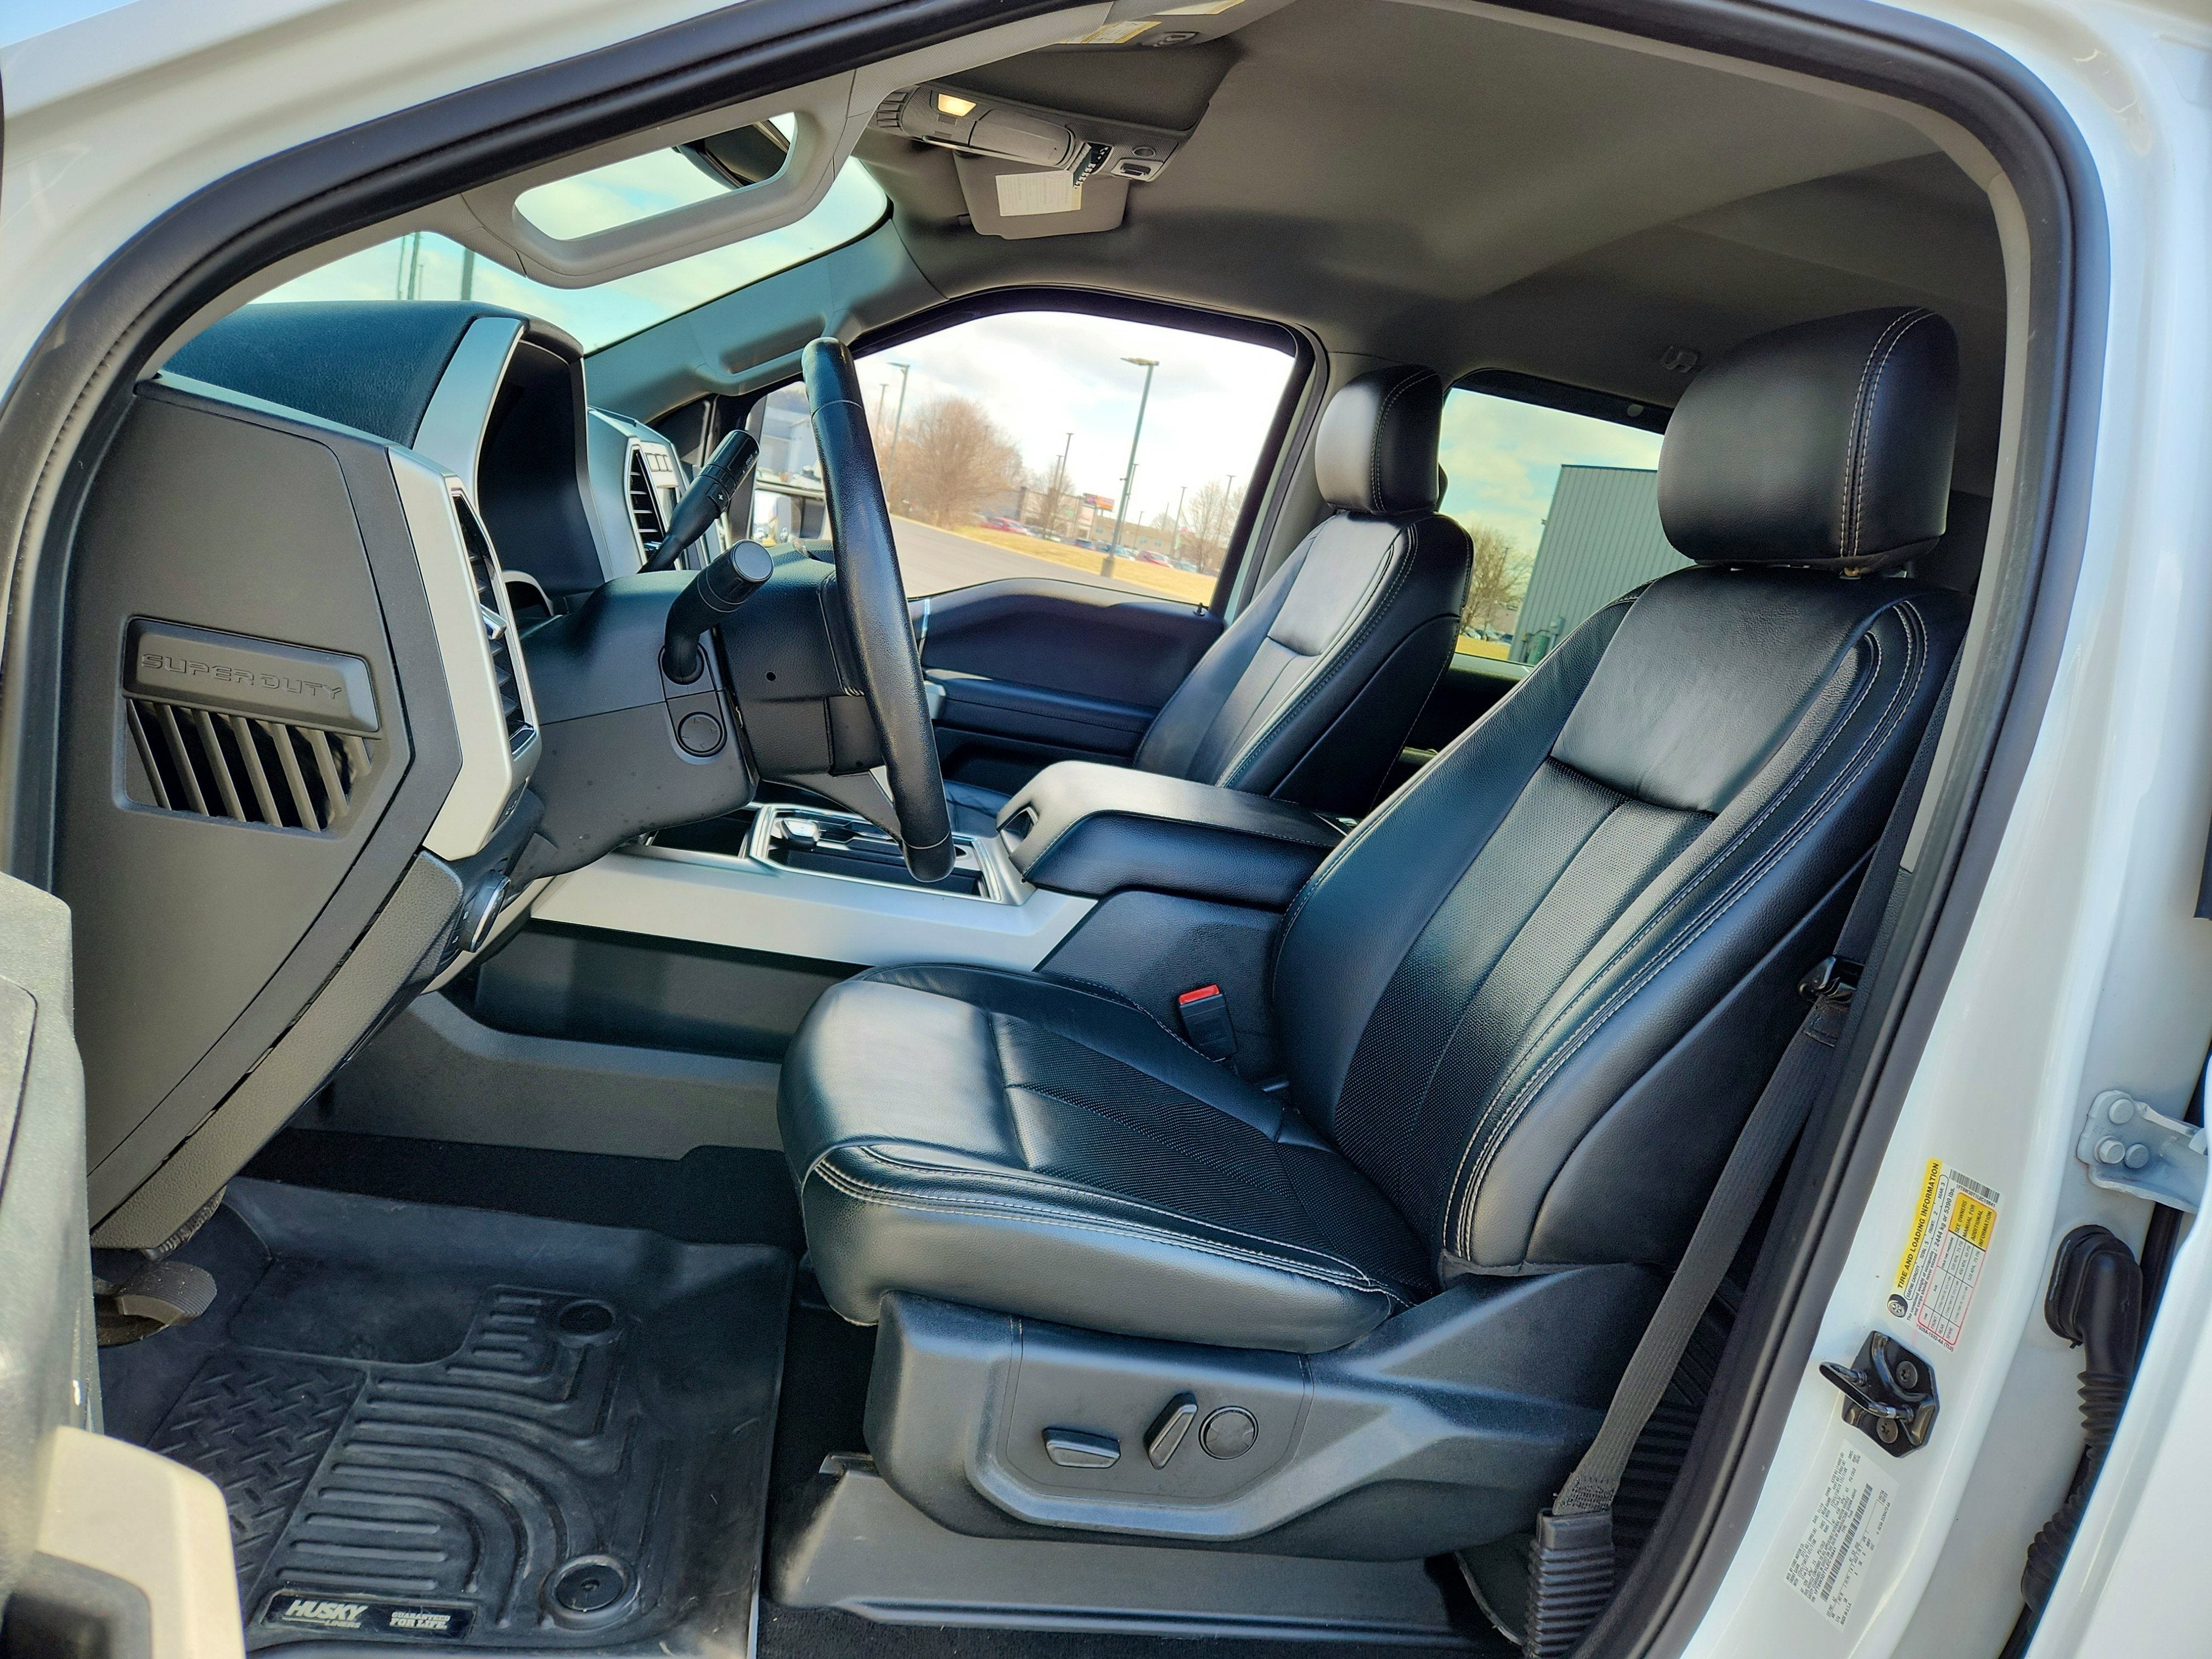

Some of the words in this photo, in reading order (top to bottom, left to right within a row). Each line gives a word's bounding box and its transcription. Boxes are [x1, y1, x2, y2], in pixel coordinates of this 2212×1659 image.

[142, 653, 255, 685] SUPER
[260, 674, 342, 699] DUTY
[1943, 1197, 1951, 1214] 5390
[1956, 1199, 1968, 1222] OWNERS
[1897, 1269, 1908, 1290] TIRE
[1904, 1252, 1914, 1271] AND
[1910, 1217, 1925, 1252] LOADING
[1920, 1161, 1939, 1217] INFORMATION
[1938, 1221, 1946, 1232] kg
[1942, 1214, 1948, 1222] or
[1961, 1215, 1972, 1238] MANUAL
[1970, 1209, 1984, 1241] ADDITIONAL
[1977, 1210, 1993, 1248] INFORMATION
[1933, 1230, 1943, 1248] 2444
[1906, 1282, 1915, 1298] SEATING
[1911, 1265, 1920, 1283] CAPACITY
[1909, 1291, 1919, 1313] combined
[1916, 1277, 1925, 1292] weight
[1923, 1250, 1934, 1273] occupants
[285, 1600, 368, 1621] HUSKY
[391, 1611, 451, 1622] GUARANTEED
[324, 1619, 361, 1629] LINERS
[390, 1618, 415, 1628] FOR
[416, 1620, 448, 1630] LIFE.
